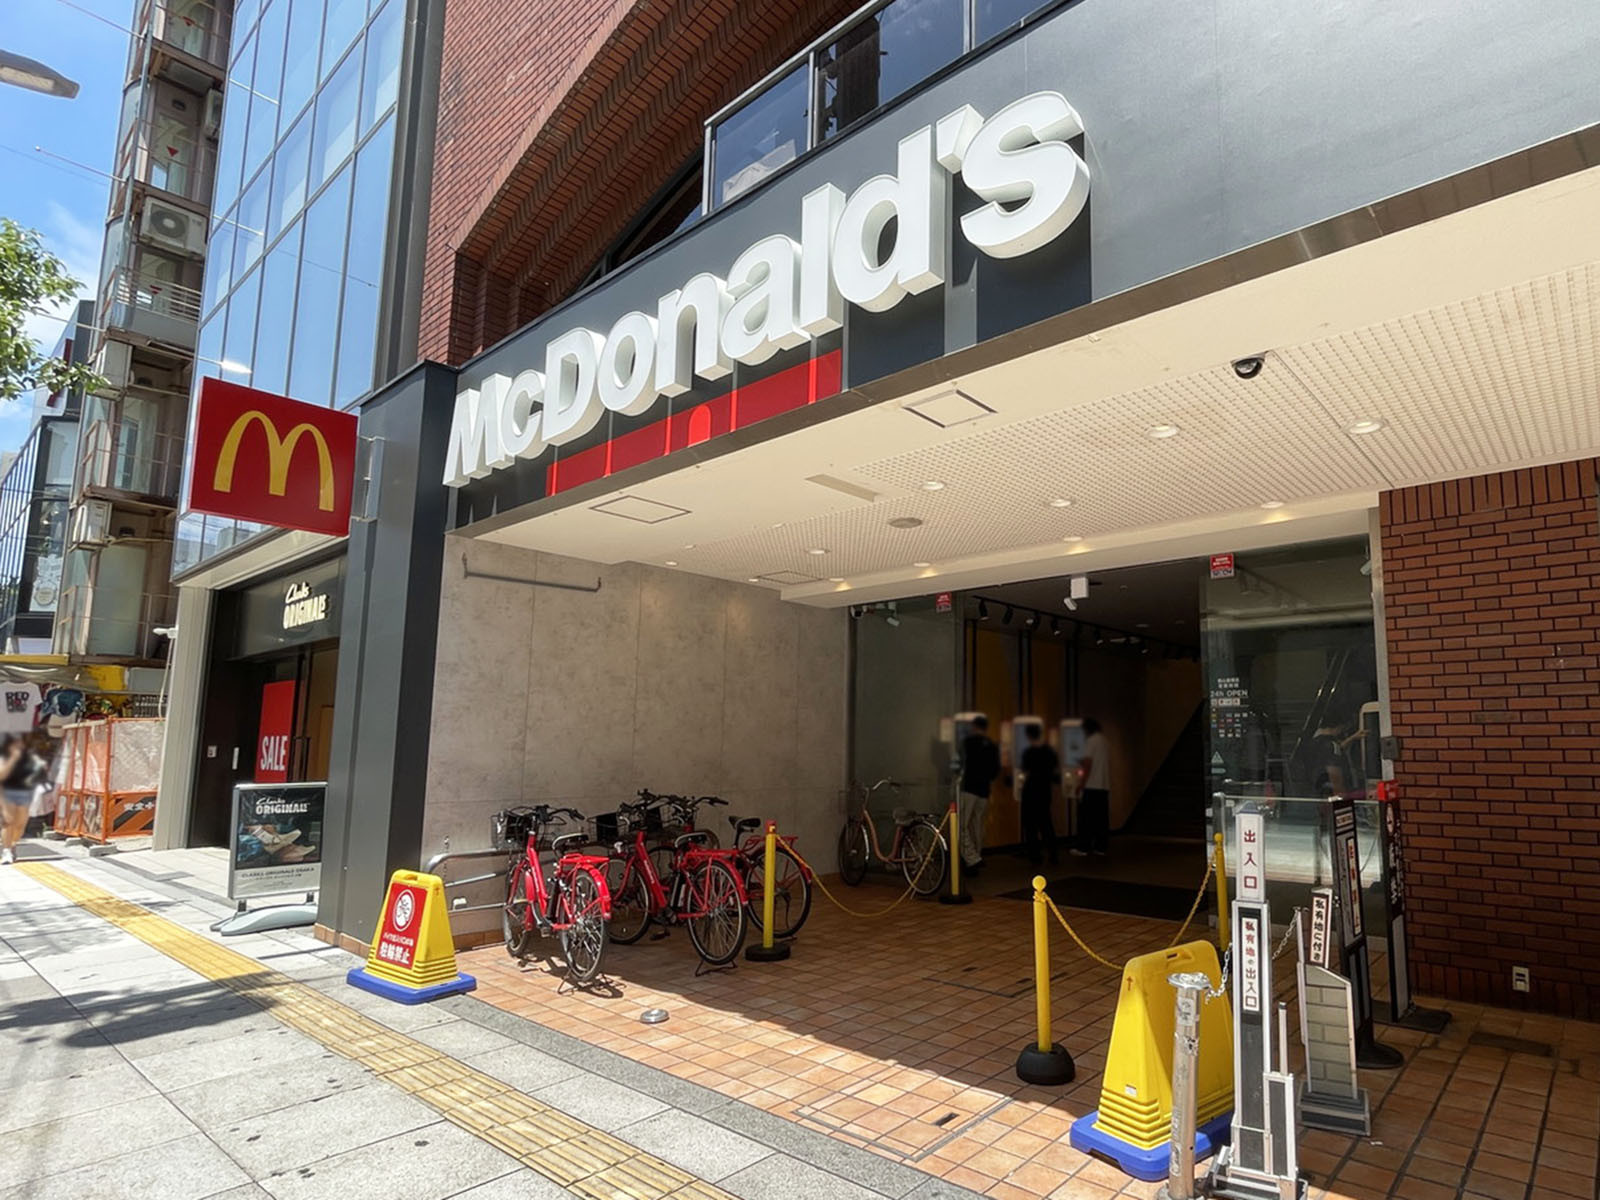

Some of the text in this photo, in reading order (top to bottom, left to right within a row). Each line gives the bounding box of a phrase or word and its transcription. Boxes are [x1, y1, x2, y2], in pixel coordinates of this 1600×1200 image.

[443, 91, 1091, 488] McDonald's
[260, 735, 288, 771] SALE
[1243, 829, 1258, 889] 出入口
